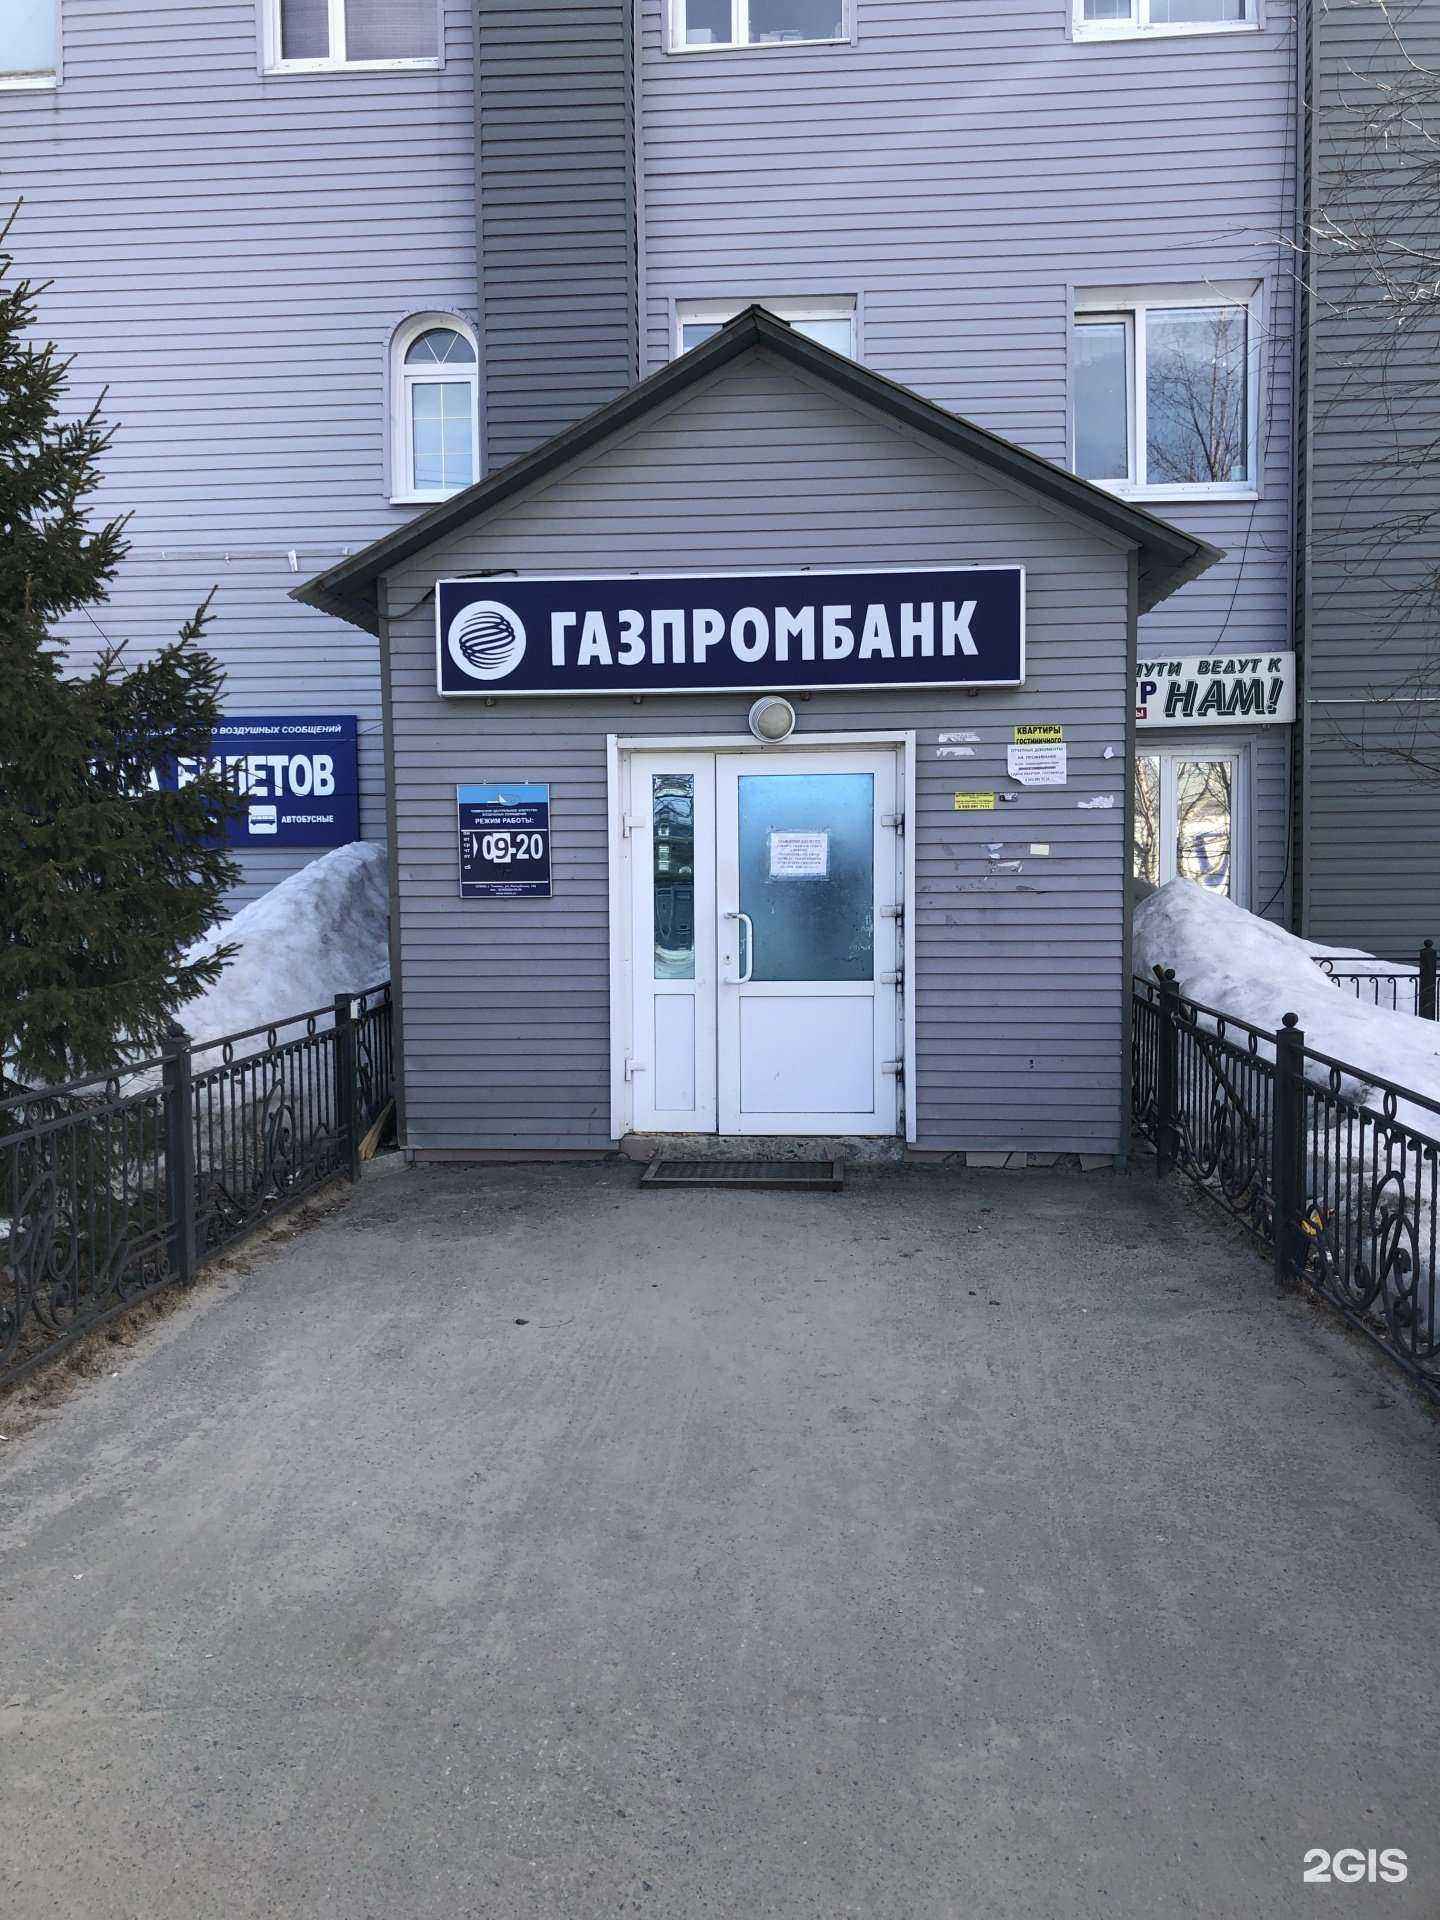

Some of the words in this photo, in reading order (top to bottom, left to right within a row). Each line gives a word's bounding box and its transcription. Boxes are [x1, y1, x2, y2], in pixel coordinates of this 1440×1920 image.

[550, 599, 980, 667] ГАЗПРОМБАНК
[1197, 658, 1263, 675] ВЕДУТ
[1267, 657, 1283, 673] К
[1164, 676, 1285, 718] НАМ!
[219, 725, 280, 735] ВОЗДУШНЫХ
[281, 724, 342, 735] СООБЩЕНИЙ
[1017, 726, 1061, 735] КВАРТИРЫ
[1016, 737, 1062, 745] ГОСТИНИЧНОГО
[281, 815, 334, 824] АВТОБУСНЫЕ
[475, 817, 501, 825] РЕЖИМ
